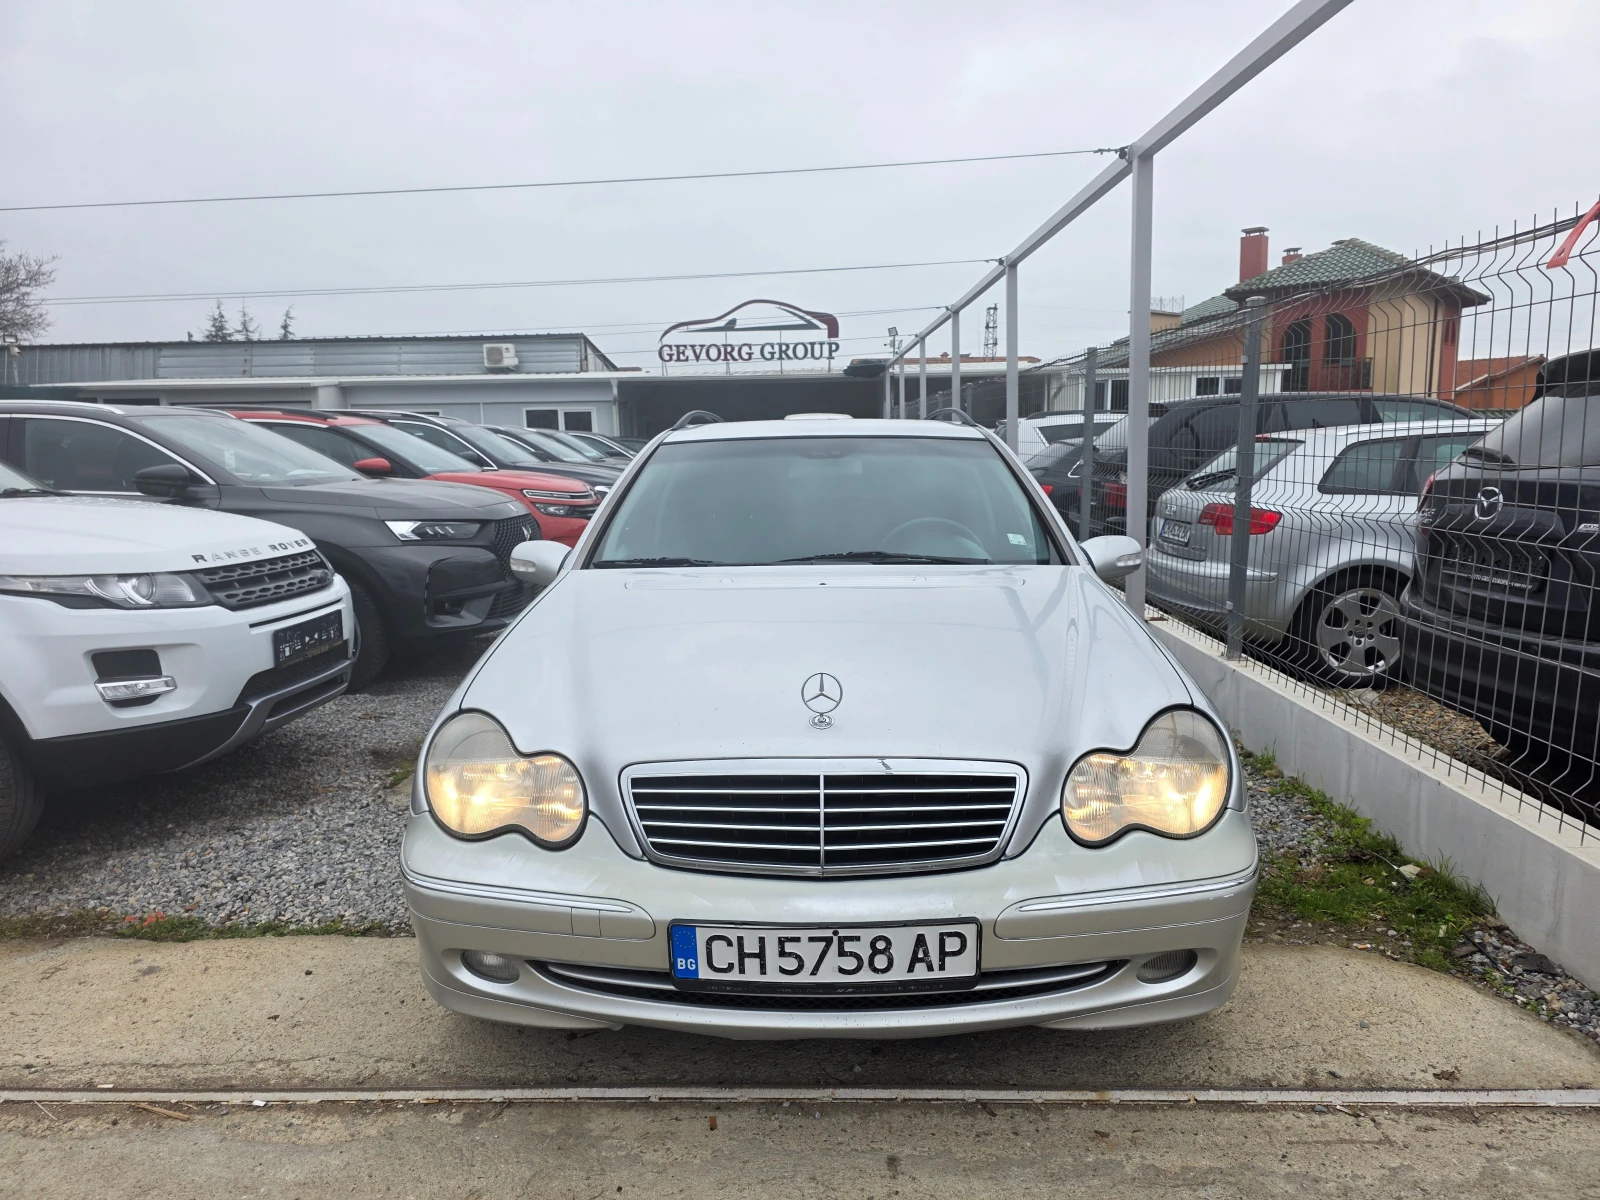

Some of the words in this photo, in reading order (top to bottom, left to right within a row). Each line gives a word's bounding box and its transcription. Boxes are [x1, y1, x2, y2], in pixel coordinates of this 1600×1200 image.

[658, 343, 754, 362] GEVORG
[760, 341, 840, 361] GROUP
[191, 547, 262, 563] RANGE
[268, 538, 309, 552] ROVER
[677, 958, 697, 971] BG
[706, 934, 767, 975] CH
[778, 935, 895, 976] 5758
[906, 930, 968, 974] AP
